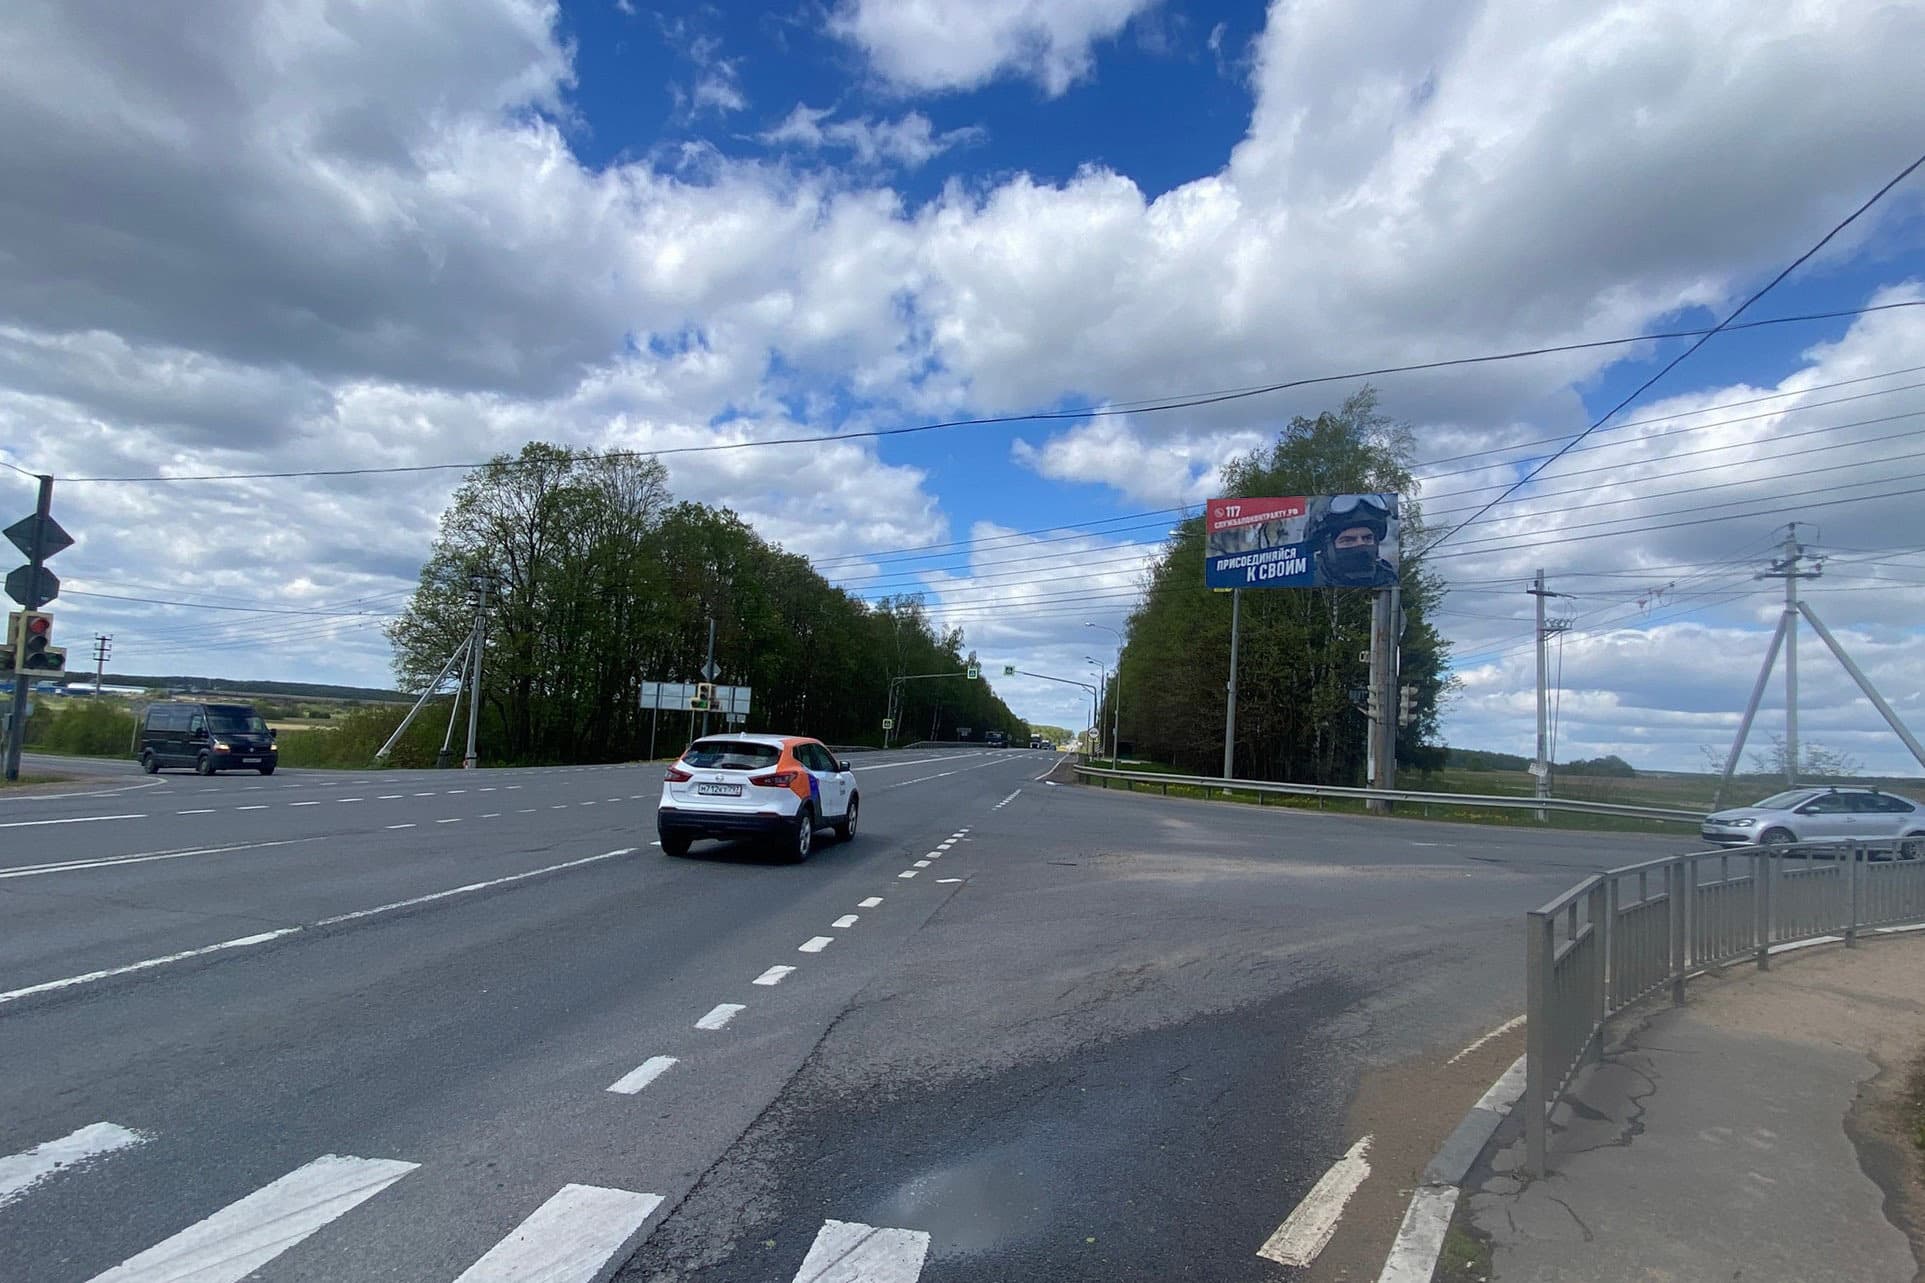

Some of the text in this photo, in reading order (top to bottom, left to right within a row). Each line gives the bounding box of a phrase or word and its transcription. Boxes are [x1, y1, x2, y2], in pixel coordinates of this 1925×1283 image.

[1226, 505, 1241, 517] 117
[1217, 548, 1297, 571] ПРИСОЕДИНЯЙСЯ
[1247, 557, 1307, 582] К СВОИМ
